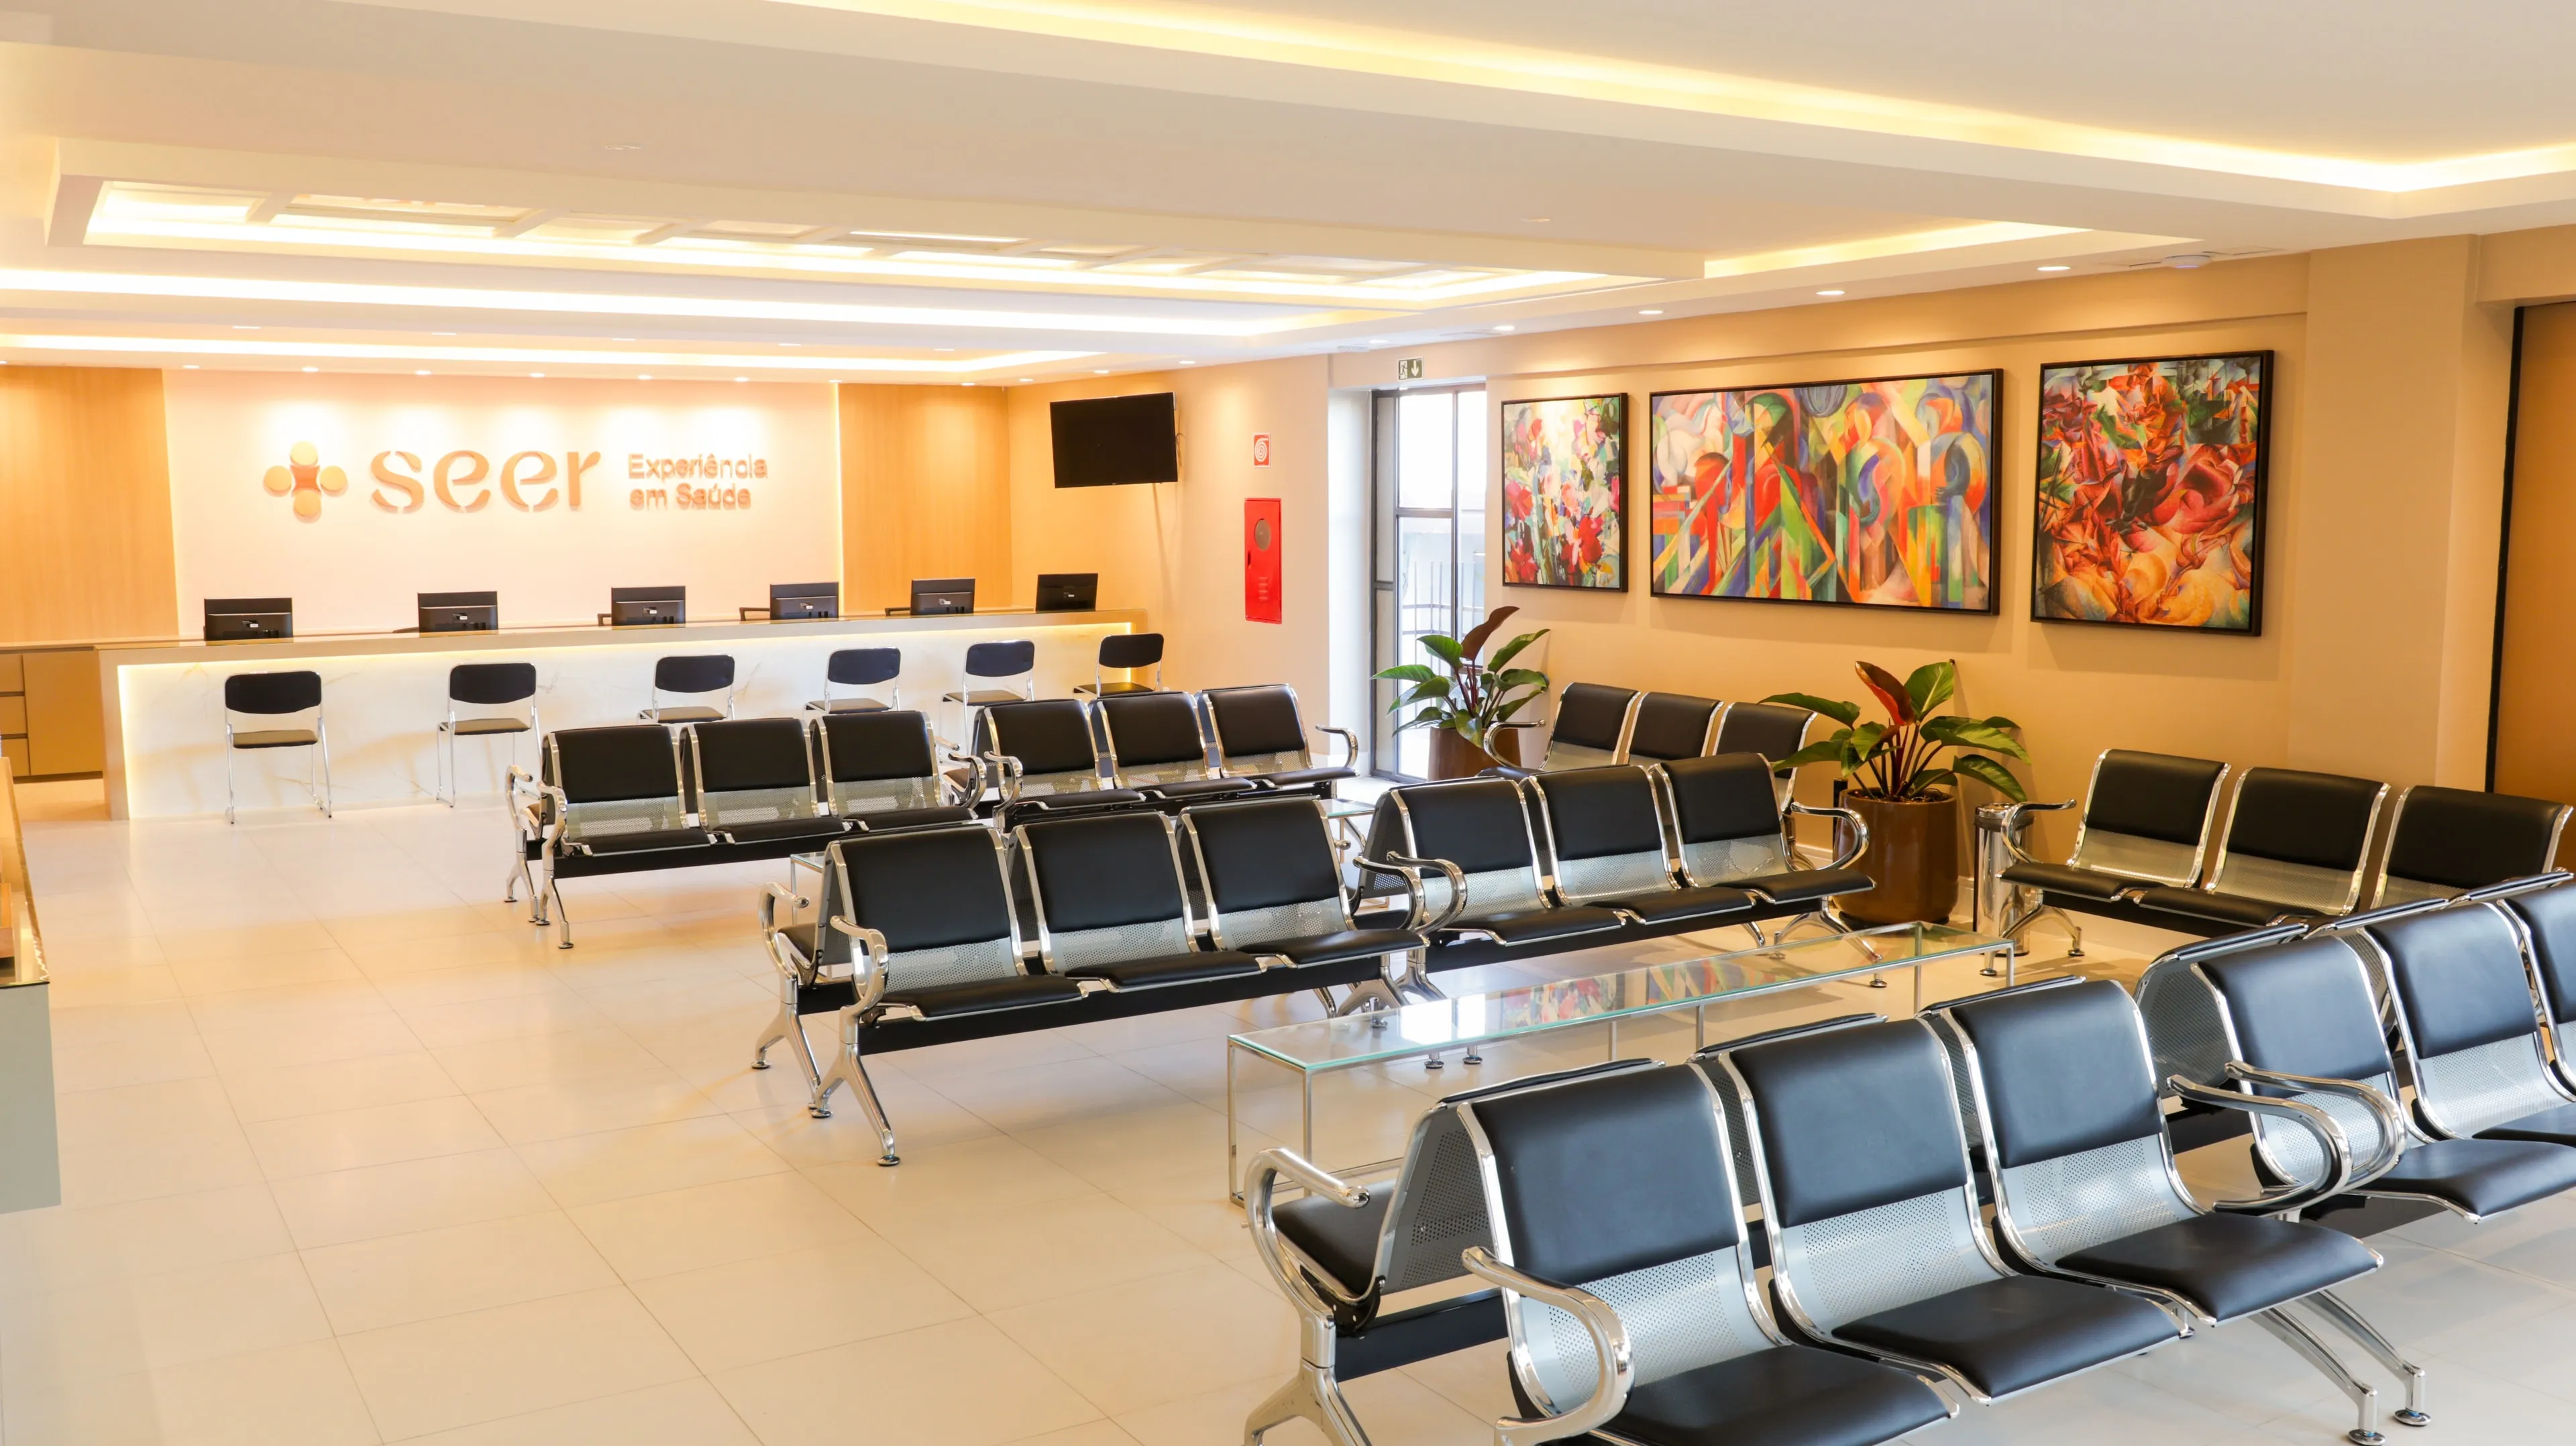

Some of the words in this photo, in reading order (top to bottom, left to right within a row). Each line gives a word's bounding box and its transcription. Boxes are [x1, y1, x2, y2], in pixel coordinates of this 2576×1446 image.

[370, 450, 601, 513] seer
[628, 453, 769, 484] Experiência
[629, 488, 668, 510] em
[676, 482, 751, 510] Saúde
